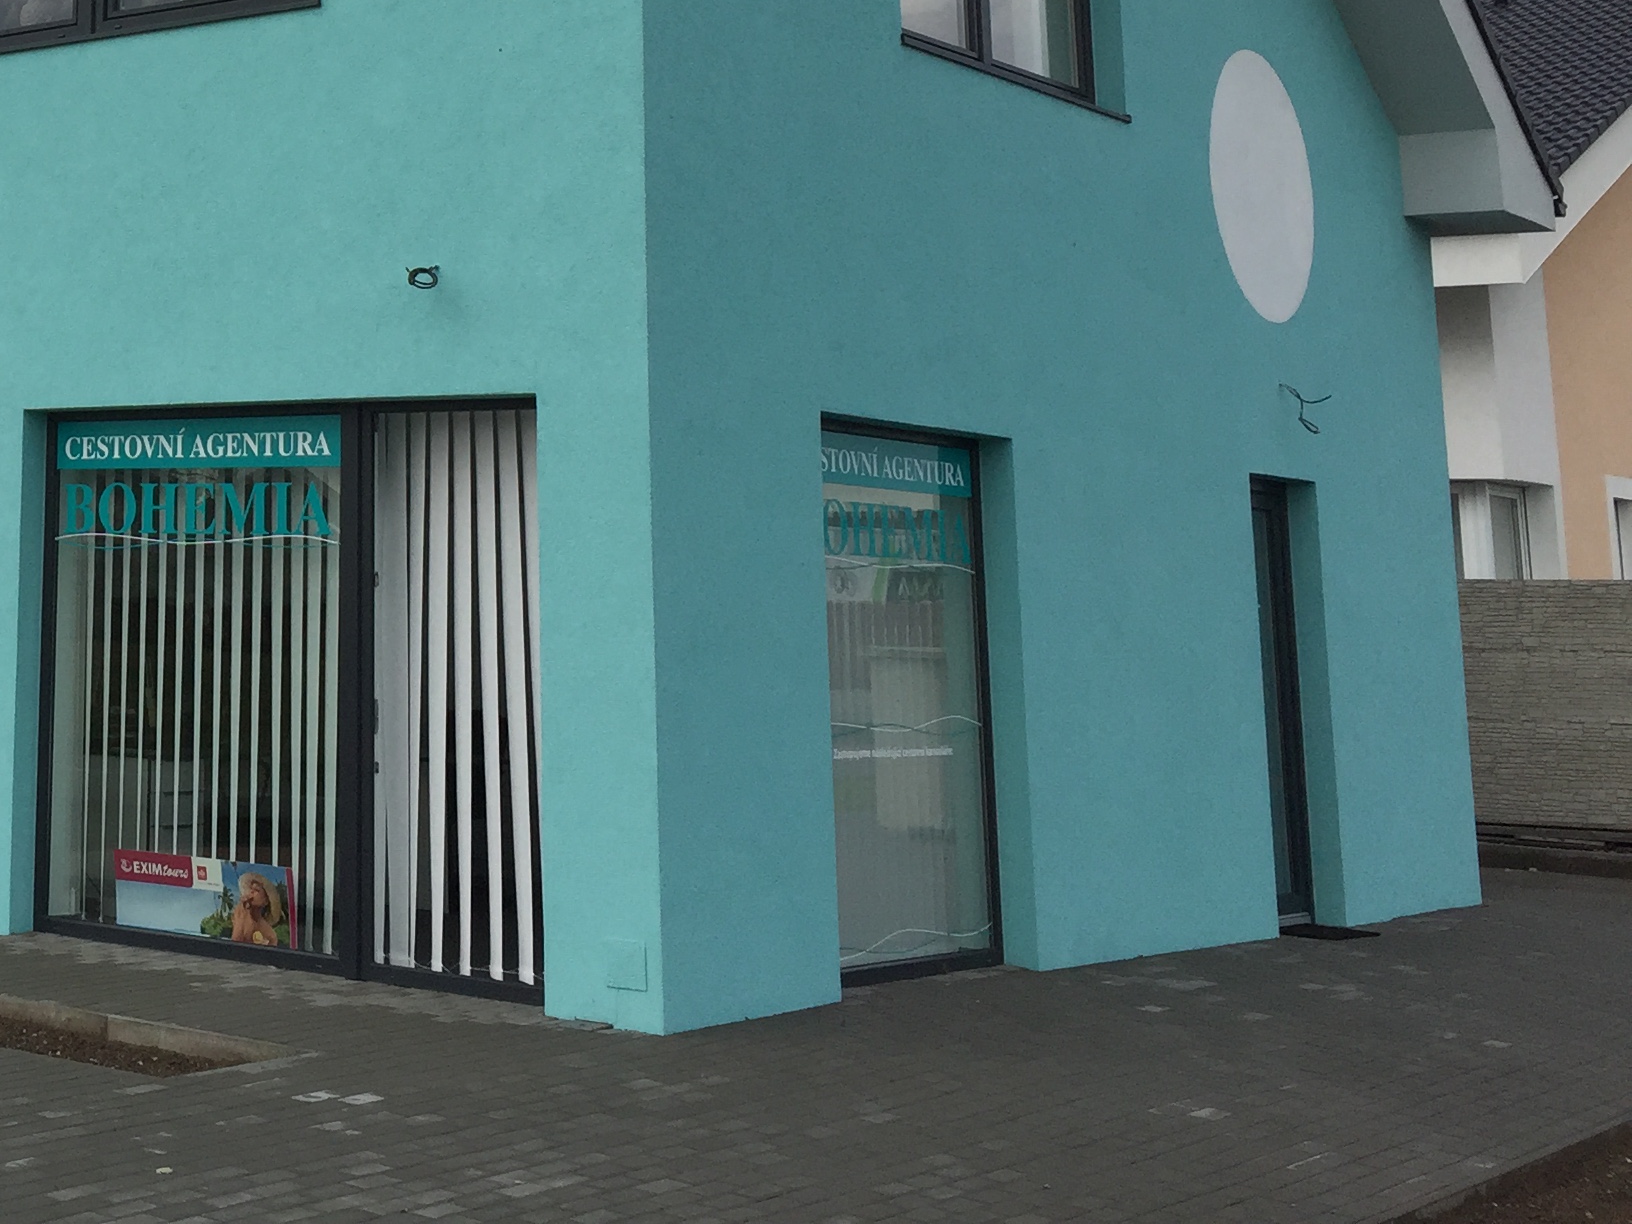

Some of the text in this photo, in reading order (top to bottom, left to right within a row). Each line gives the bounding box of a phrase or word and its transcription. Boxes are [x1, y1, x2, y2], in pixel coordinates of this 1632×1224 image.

[64, 427, 332, 460] CESTOVNÍ AGENTURA
[820, 446, 965, 487] STOVNÍ AGENTURA
[64, 481, 332, 535] BOHEMIA
[822, 498, 972, 564] OHEMIA
[133, 860, 189, 879] EXIMtours
